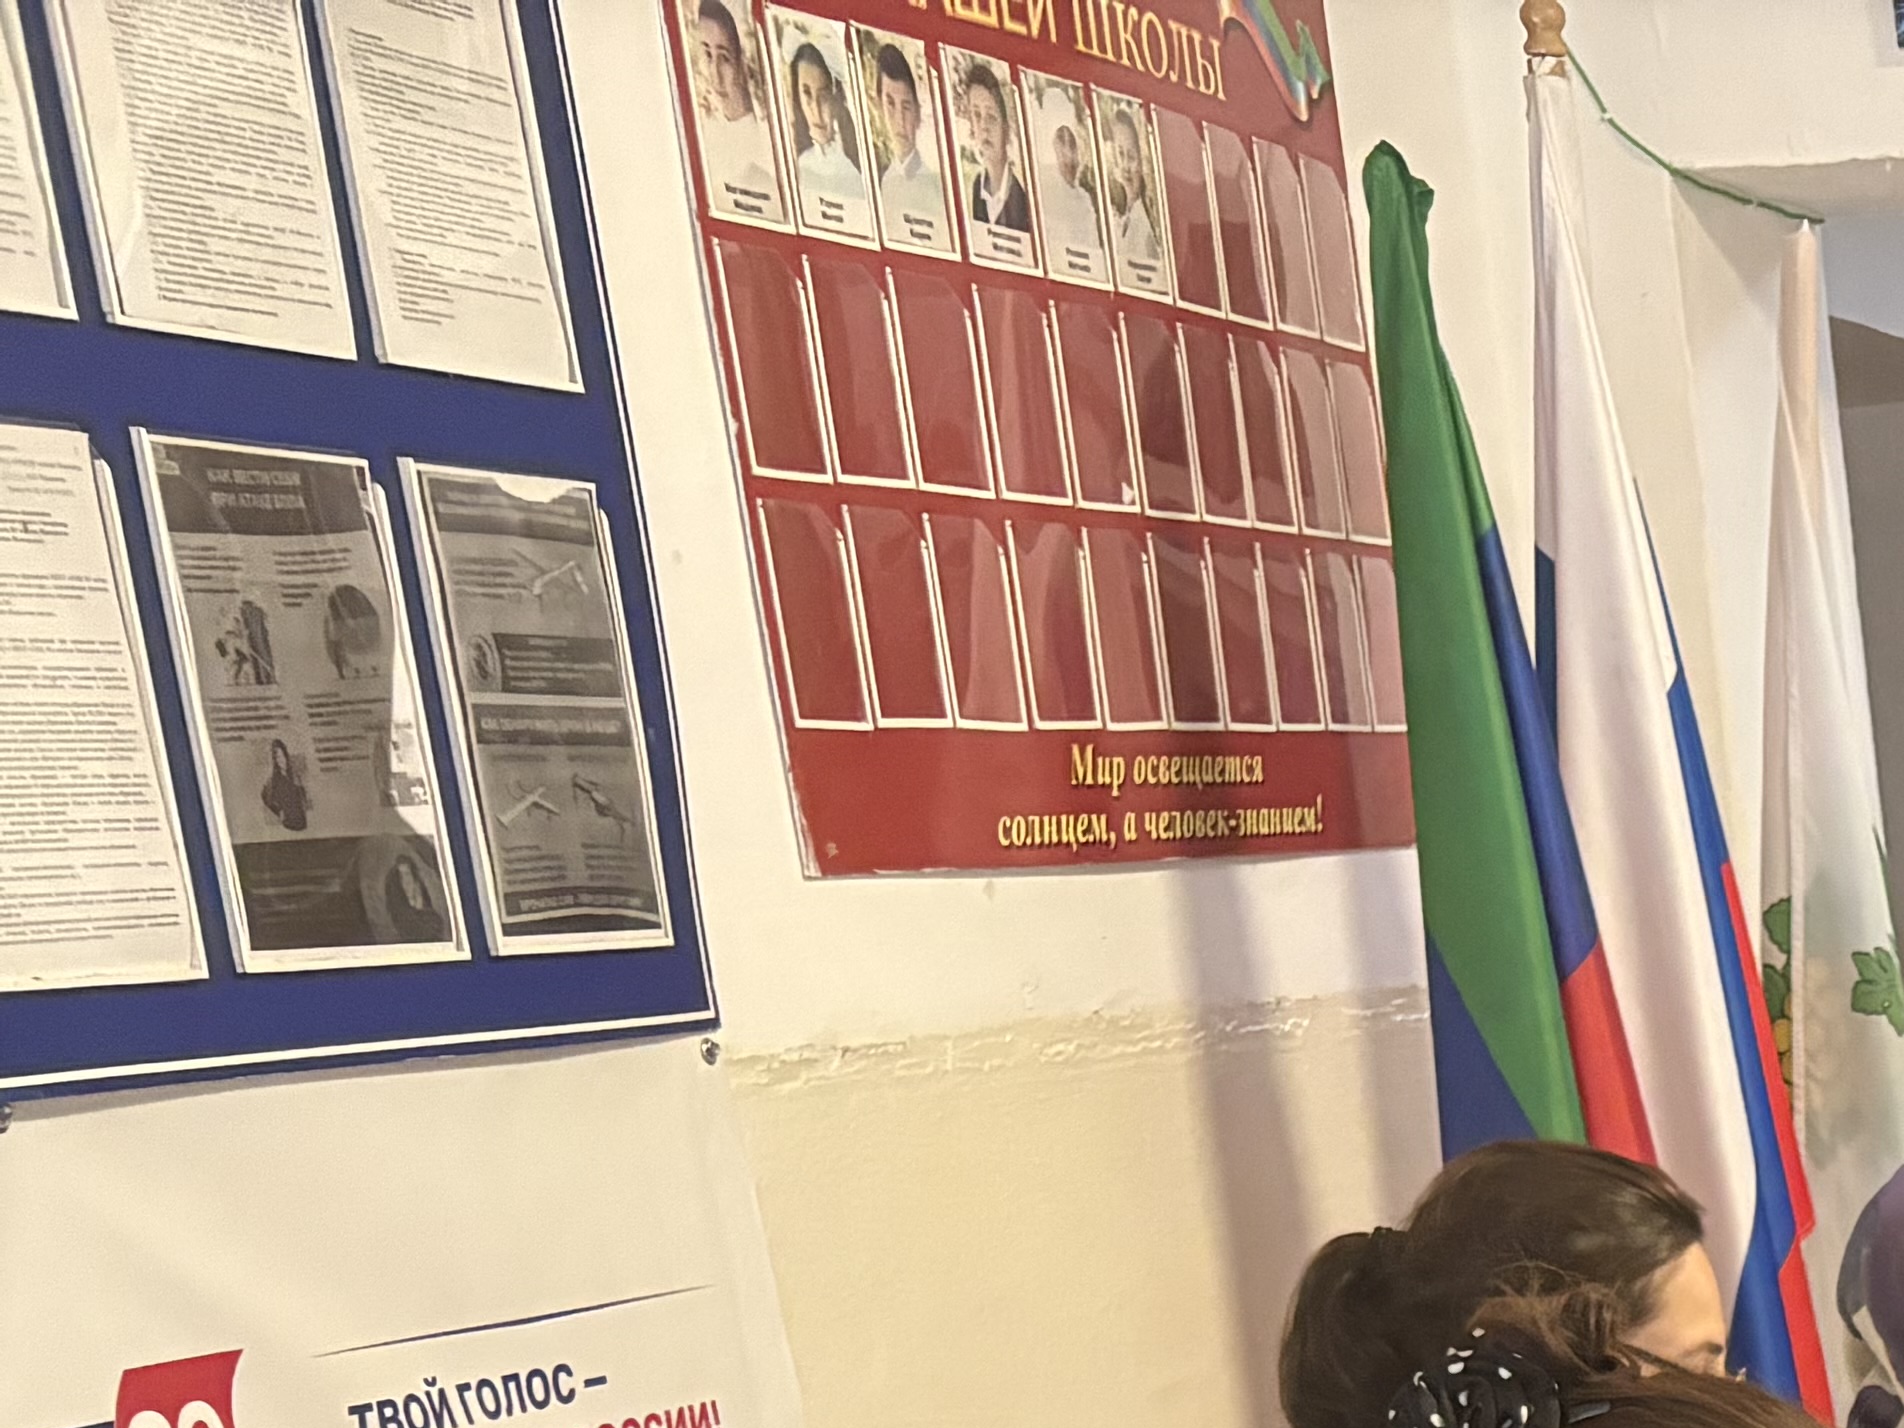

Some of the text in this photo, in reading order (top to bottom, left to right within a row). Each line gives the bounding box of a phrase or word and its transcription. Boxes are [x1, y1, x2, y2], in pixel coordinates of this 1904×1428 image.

[1071, 0, 1227, 101] ШКОЛЫ
[1070, 743, 1264, 797] Мир освещается
[998, 813, 1117, 853] солнцем,
[1124, 811, 1137, 841] а
[461, 1362, 577, 1428] ГОЛОС
